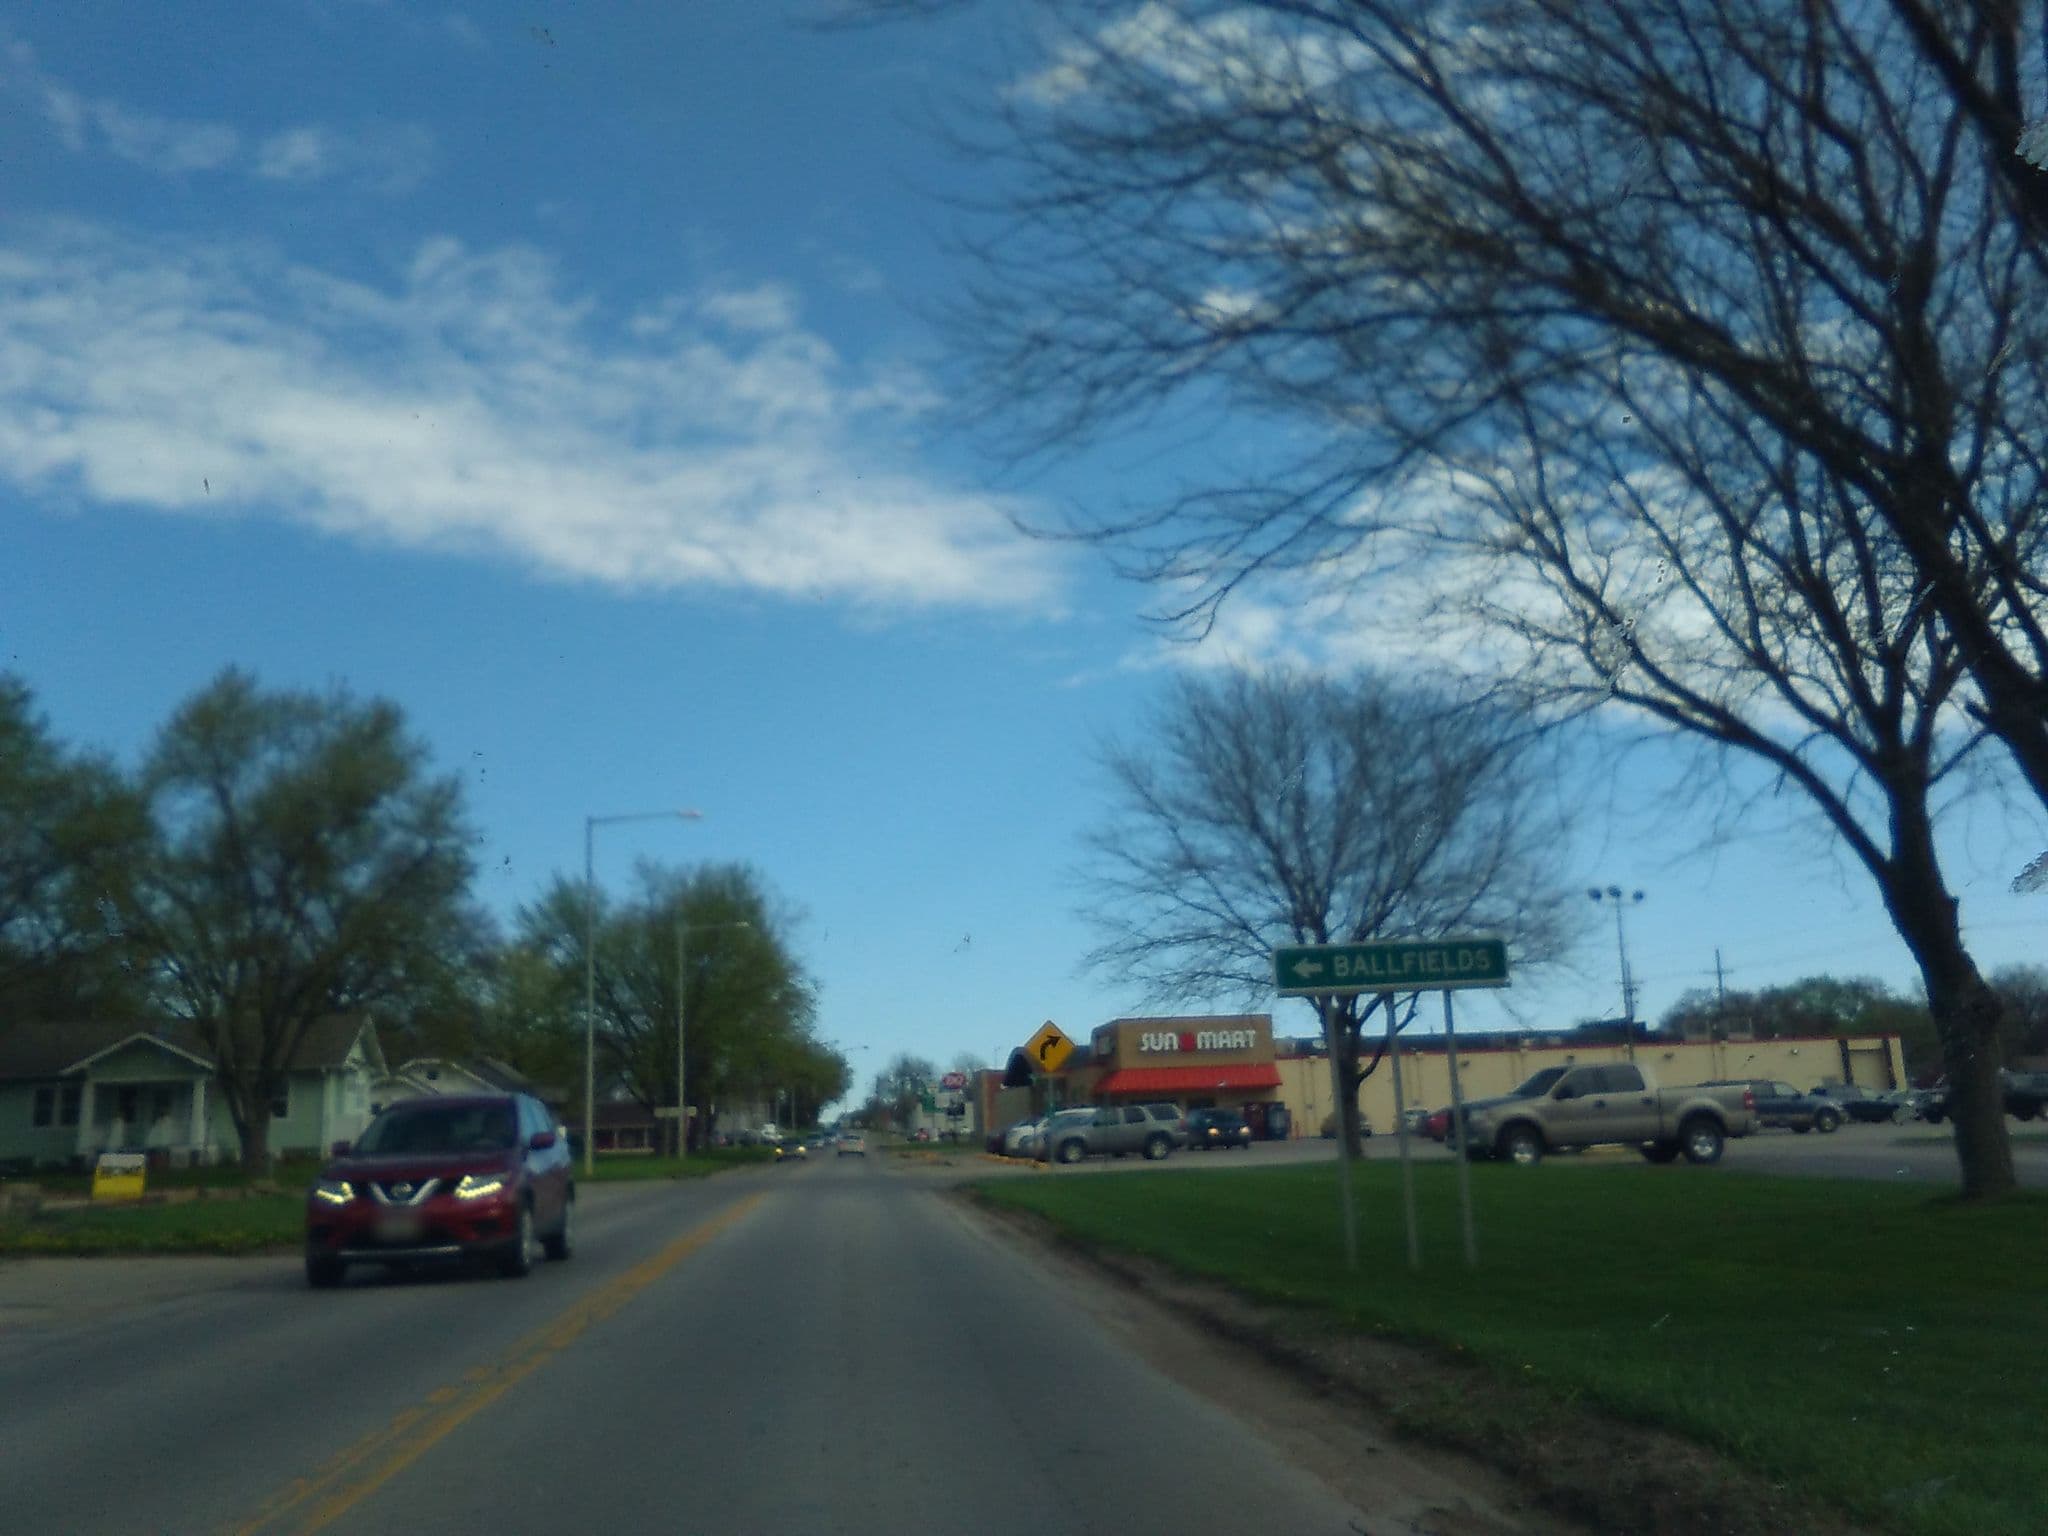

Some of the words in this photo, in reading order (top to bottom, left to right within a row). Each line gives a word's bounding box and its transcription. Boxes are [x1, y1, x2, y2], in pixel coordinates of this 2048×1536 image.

[1334, 949, 1490, 977] BALLFIELDS
[1140, 1031, 1179, 1052] SUN
[1196, 1029, 1257, 1050] MART
